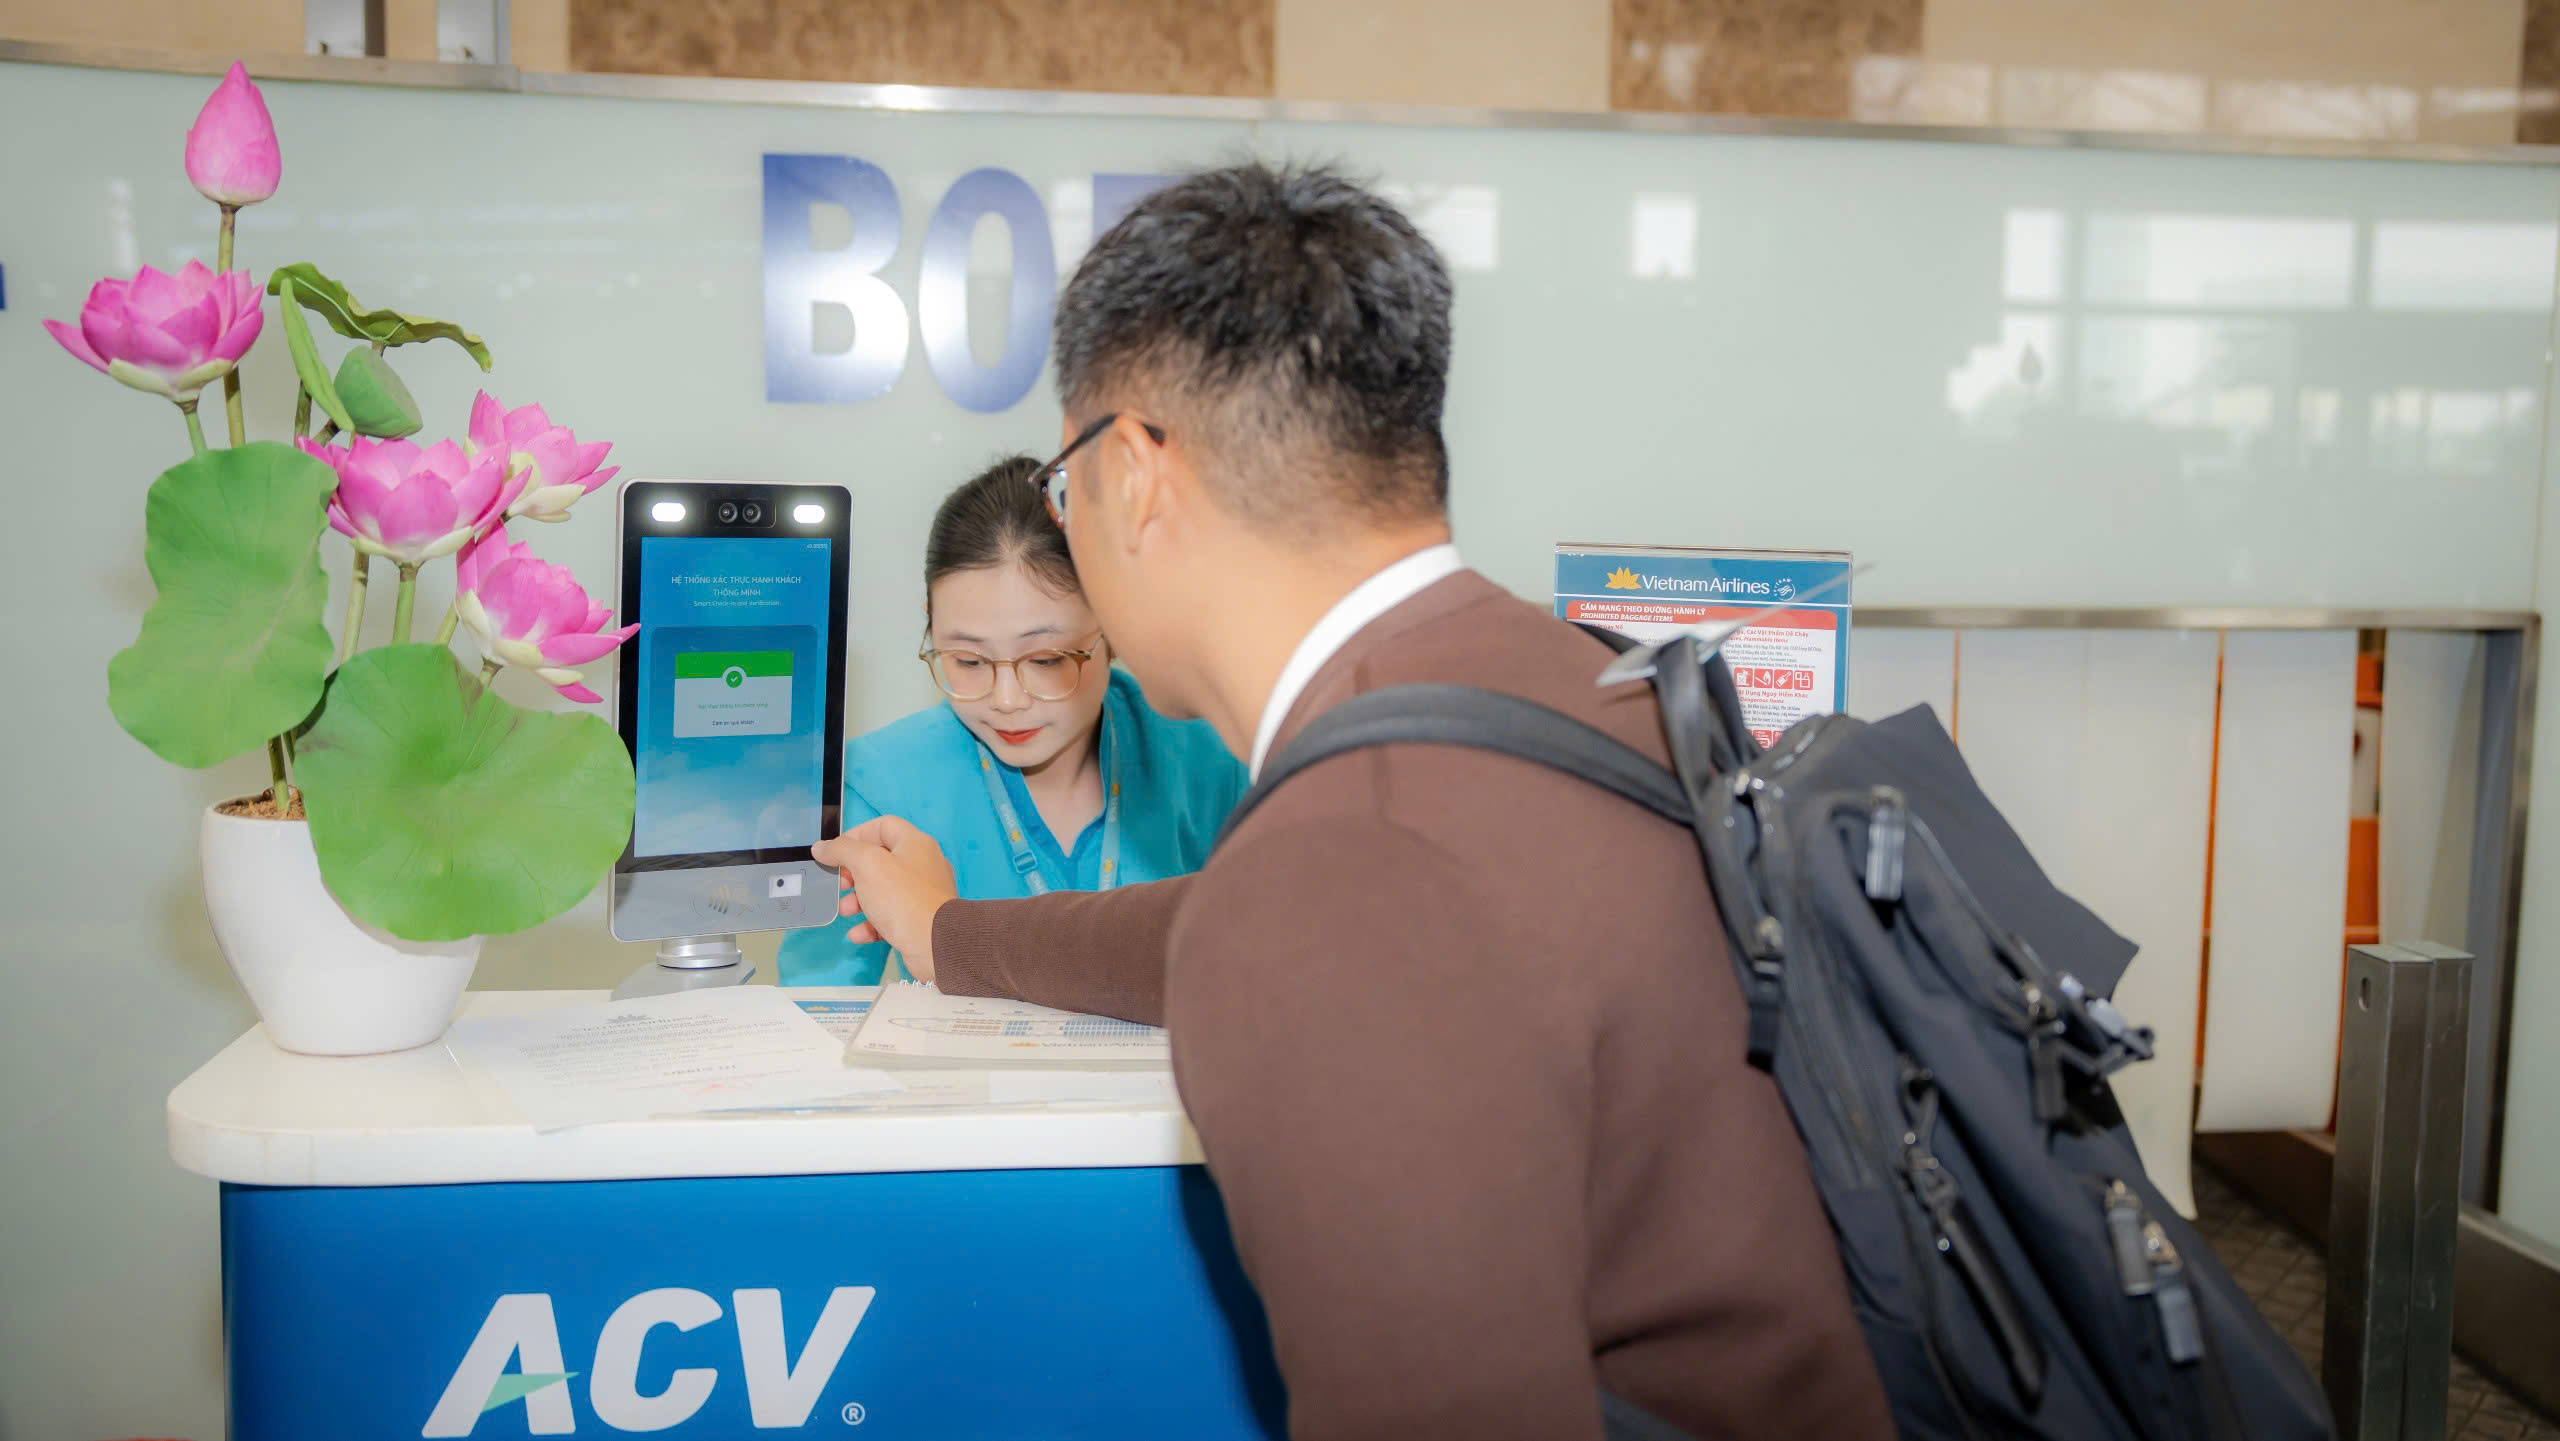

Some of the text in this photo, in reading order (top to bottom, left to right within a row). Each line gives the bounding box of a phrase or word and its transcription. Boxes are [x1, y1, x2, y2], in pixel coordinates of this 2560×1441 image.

[1641, 574, 1770, 594] Vietnam Airlines
[740, 588, 761, 597] MINH
[1580, 602, 1598, 611] CẤM
[1598, 604, 1622, 612] MANG
[1622, 605, 1643, 613] THEO
[1643, 604, 1672, 614] ĐƯỜNG
[1673, 605, 1697, 615] HÀNH
[1579, 612, 1620, 620] PROHIBITED
[1620, 614, 1652, 622] BAGGAGE
[421, 1286, 876, 1438] ACV
